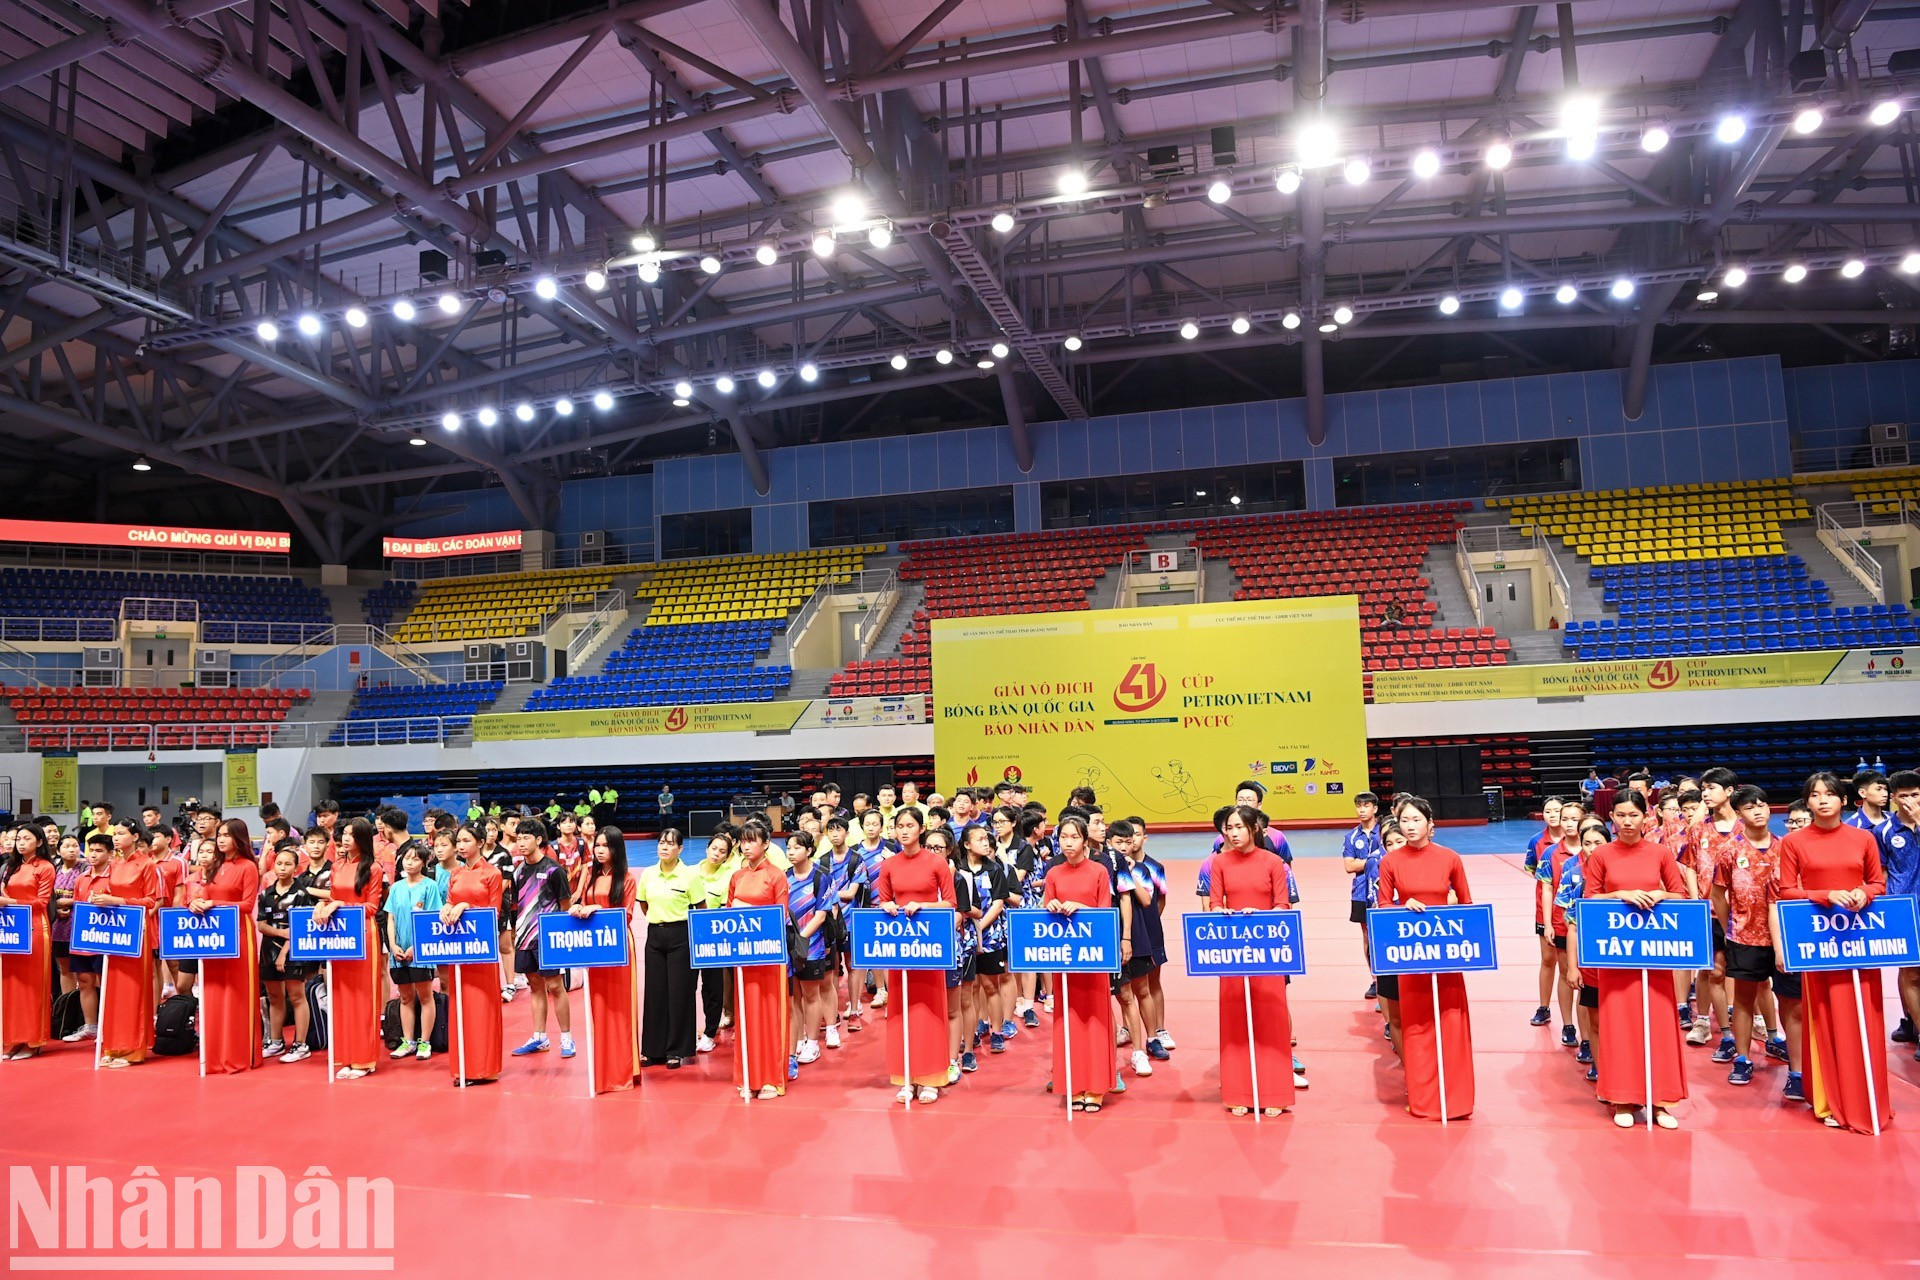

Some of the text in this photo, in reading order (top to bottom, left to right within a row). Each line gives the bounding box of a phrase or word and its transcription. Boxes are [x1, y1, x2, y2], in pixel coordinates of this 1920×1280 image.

[170, 530, 212, 544] MỪNG
[214, 533, 237, 546] QUÍ
[240, 536, 252, 549] VỊ
[254, 536, 276, 549] ĐẠI
[279, 537, 291, 548] BI
[392, 542, 412, 555] ĐẠI
[442, 538, 463, 551] CÁC
[465, 536, 493, 550] ĐOÀN
[495, 534, 516, 549] VẬN
[1157, 554, 1170, 568] B
[1650, 660, 1674, 682] 41
[1686, 659, 1707, 668] CÚP
[1688, 667, 1767, 677] PETROVIETNAM
[1119, 663, 1157, 700] 41
[1181, 673, 1214, 689] CÚP
[1543, 675, 1569, 684] BÓNG
[1572, 674, 1591, 683] BÀN
[1593, 672, 1620, 682] QUỐC
[1568, 681, 1640, 693] BÁO NHÂN DÂN
[1688, 679, 1721, 687] PVCFC
[994, 681, 1094, 697] GIẢI VÔ ĐỊCH
[944, 698, 1095, 718] BÓNG BÀN QUỐC GIA
[1183, 690, 1312, 708] PETROVIETNAM
[667, 707, 684, 726] 41
[694, 713, 752, 722] PETROVIETNAM
[1183, 714, 1234, 729] PVCFC
[984, 718, 1095, 736] BÁO NHÂN DÂN
[148, 752, 155, 762] 4
[88, 911, 127, 927] ĐOÀN
[710, 913, 762, 934] ĐOÀN
[874, 917, 930, 937] ĐOÀN
[1033, 917, 1093, 939] ĐOÀN
[1397, 914, 1464, 938] ĐOÀN
[0, 928, 19, 945] ẴNG
[81, 926, 131, 946] ĐỒNG NAI
[173, 932, 225, 950] HÀ NỘI
[548, 926, 617, 951] TRỌNG TÀI
[1195, 920, 1290, 943] CÂU LẠC BỘ
[298, 933, 356, 950] HẢI PHÒNG
[421, 937, 490, 957] KHÁNH HÒA
[694, 942, 717, 958] LONG
[717, 938, 732, 957] HẢI
[737, 937, 752, 956] HẢI
[753, 939, 782, 955] DƯƠNG
[864, 938, 943, 958] LÂM ĐỒNG
[1596, 935, 1694, 957] TÂY NINH
[1797, 935, 1909, 960] TP HỒ CHÍ MINH
[1024, 943, 1103, 965] NGHỆ AN
[1197, 944, 1293, 965] NGUYÊN VÕ
[1385, 941, 1481, 963] QUÂN ĐỘI
